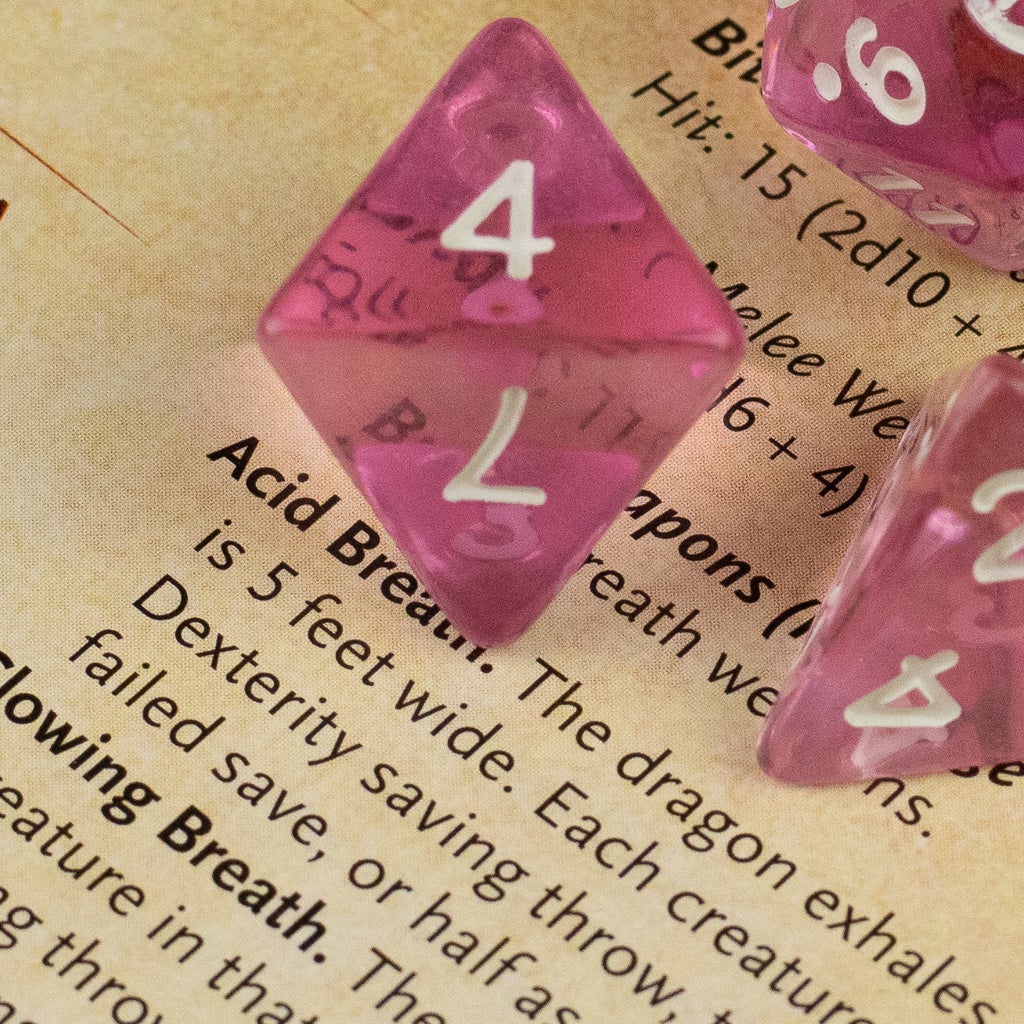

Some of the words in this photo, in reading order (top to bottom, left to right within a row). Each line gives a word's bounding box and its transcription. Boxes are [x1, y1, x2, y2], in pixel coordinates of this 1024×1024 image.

[440, 159, 556, 281] 4
[631, 71, 735, 154] Hit:
[740, 143, 807, 201] 15
[796, 199, 951, 308] (2d10
[953, 313, 983, 338] +
[443, 387, 548, 506] 7
[812, 463, 870, 519] 4)
[194, 519, 246, 571] is
[246, 561, 300, 603] 5
[289, 593, 396, 687] feet
[394, 678, 514, 793] wide.
[533, 780, 662, 892] Each
[206, 435, 341, 534] Acid
[518, 656, 612, 753] The
[616, 747, 800, 891] dragon
[804, 888, 998, 1024] exhales
[844, 650, 962, 729] 4
[68, 627, 227, 754] failed
[211, 752, 329, 864] save,
[347, 857, 413, 904] or
[410, 892, 538, 987] half
[132, 574, 363, 767] Dexterity
[359, 762, 531, 902] saving
[529, 884, 686, 1024] throw,
[147, 904, 205, 964] in
[207, 954, 317, 1024] tha
[157, 804, 329, 964] Breath.
